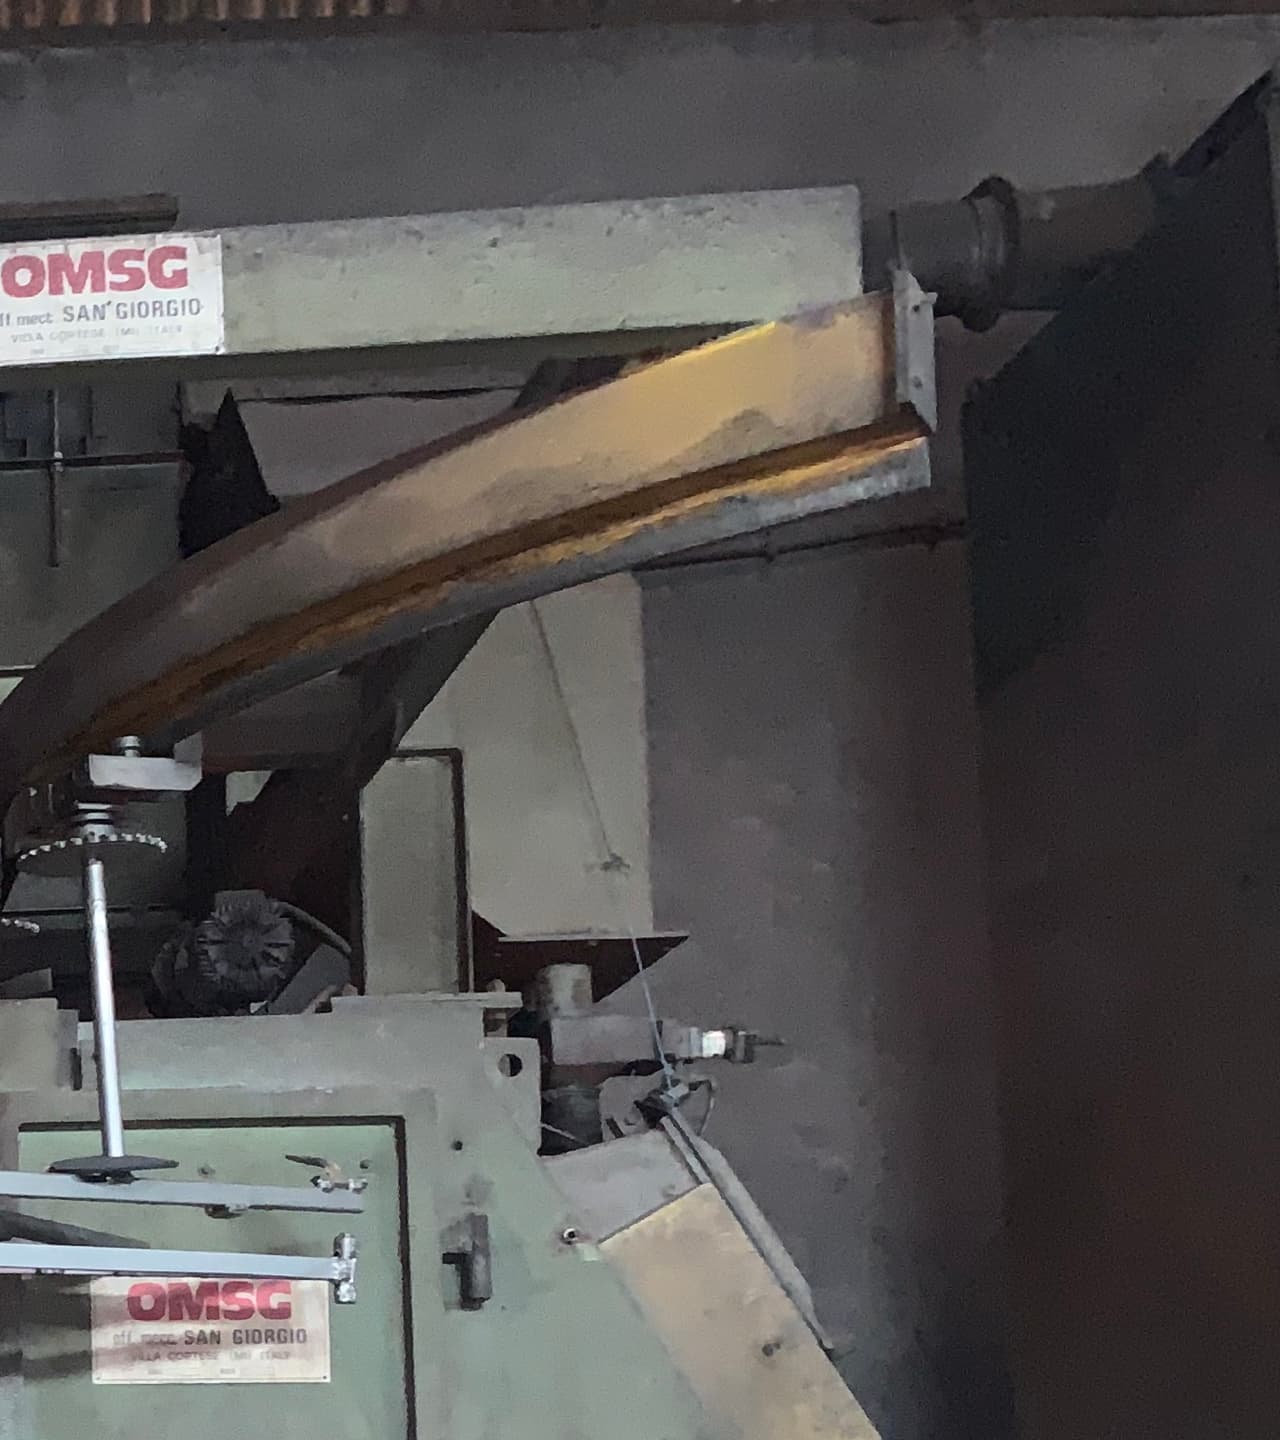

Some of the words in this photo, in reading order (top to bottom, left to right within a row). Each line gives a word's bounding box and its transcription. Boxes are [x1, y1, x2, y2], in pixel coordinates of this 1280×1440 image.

[1, 246, 188, 298] OMSG
[127, 1280, 291, 1321] OMSG
[184, 1329, 221, 1345] SAN
[233, 1328, 307, 1345] GIORGIO
